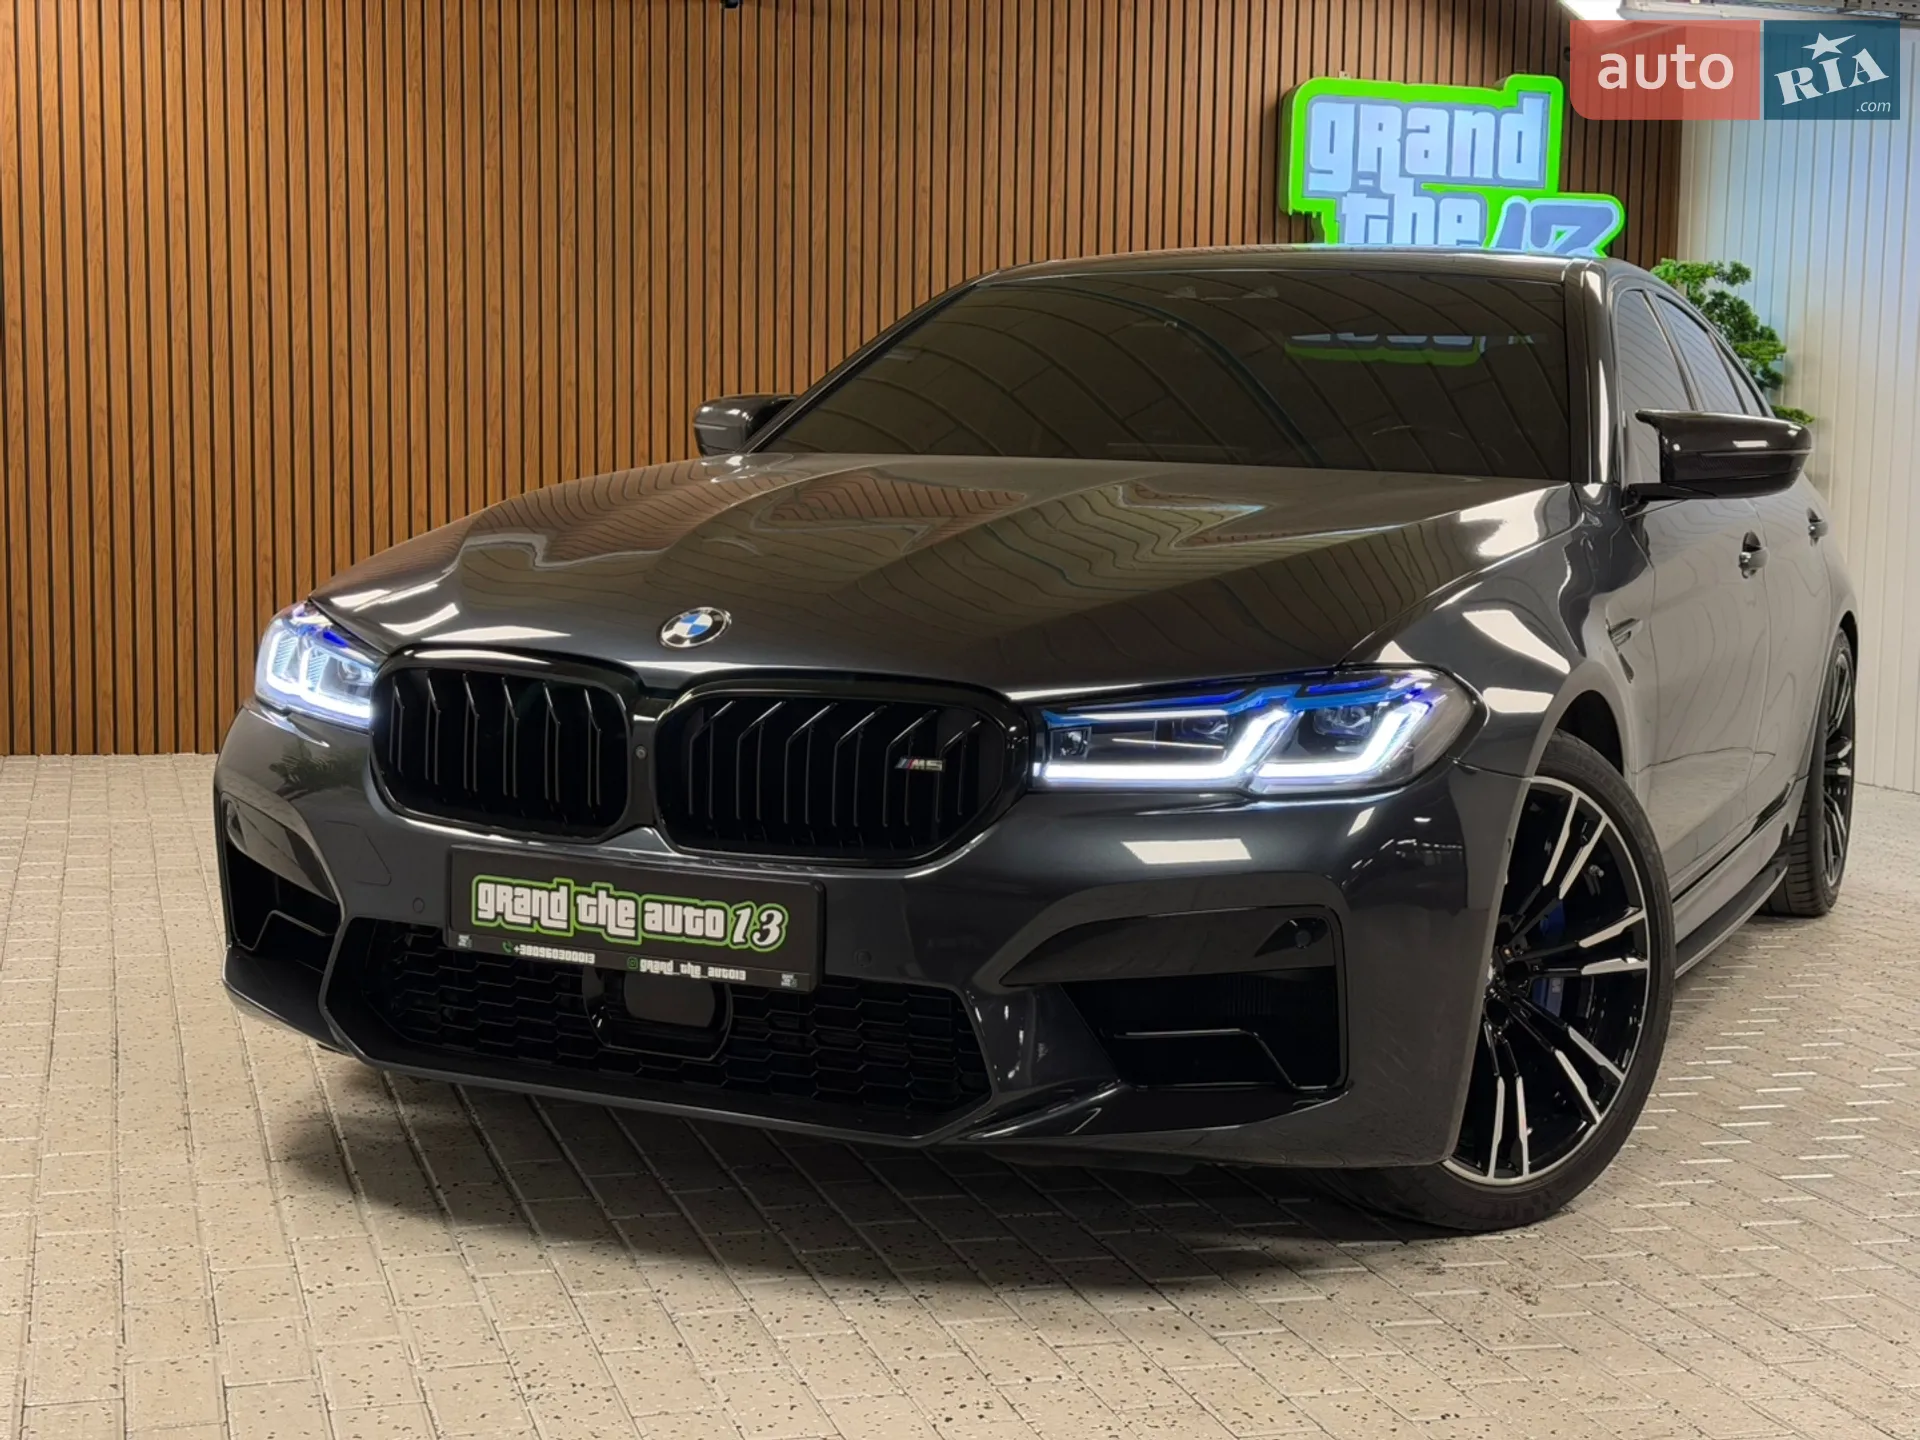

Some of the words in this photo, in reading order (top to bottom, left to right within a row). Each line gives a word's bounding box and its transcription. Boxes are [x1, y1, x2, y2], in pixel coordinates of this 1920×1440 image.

[576, 889, 636, 937] the
[644, 901, 725, 939] auto
[732, 907, 784, 946] 13
